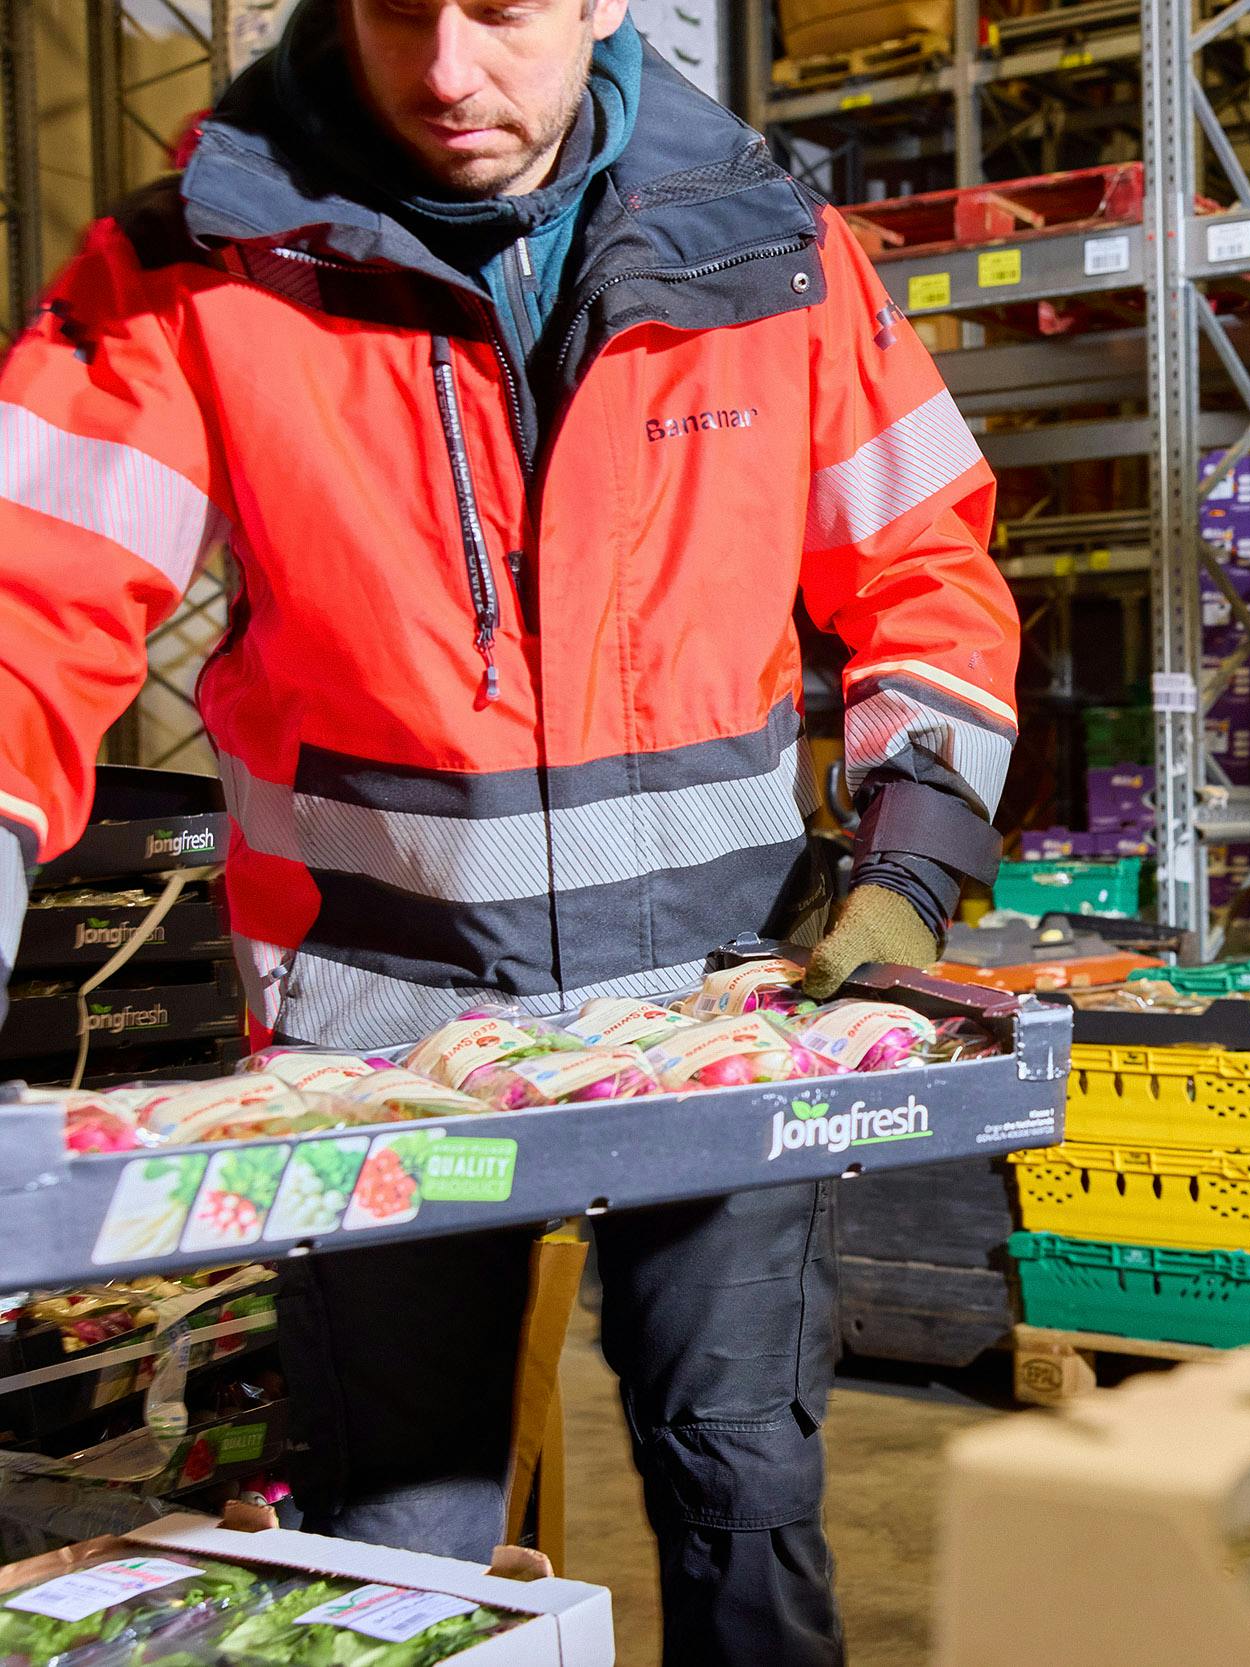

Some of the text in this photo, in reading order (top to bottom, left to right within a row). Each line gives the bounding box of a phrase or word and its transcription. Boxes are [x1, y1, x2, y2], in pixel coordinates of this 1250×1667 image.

[144, 827, 214, 859] Jongfresh
[768, 1095, 929, 1161] Jongfresh
[427, 1154, 511, 1178] QUALITY
